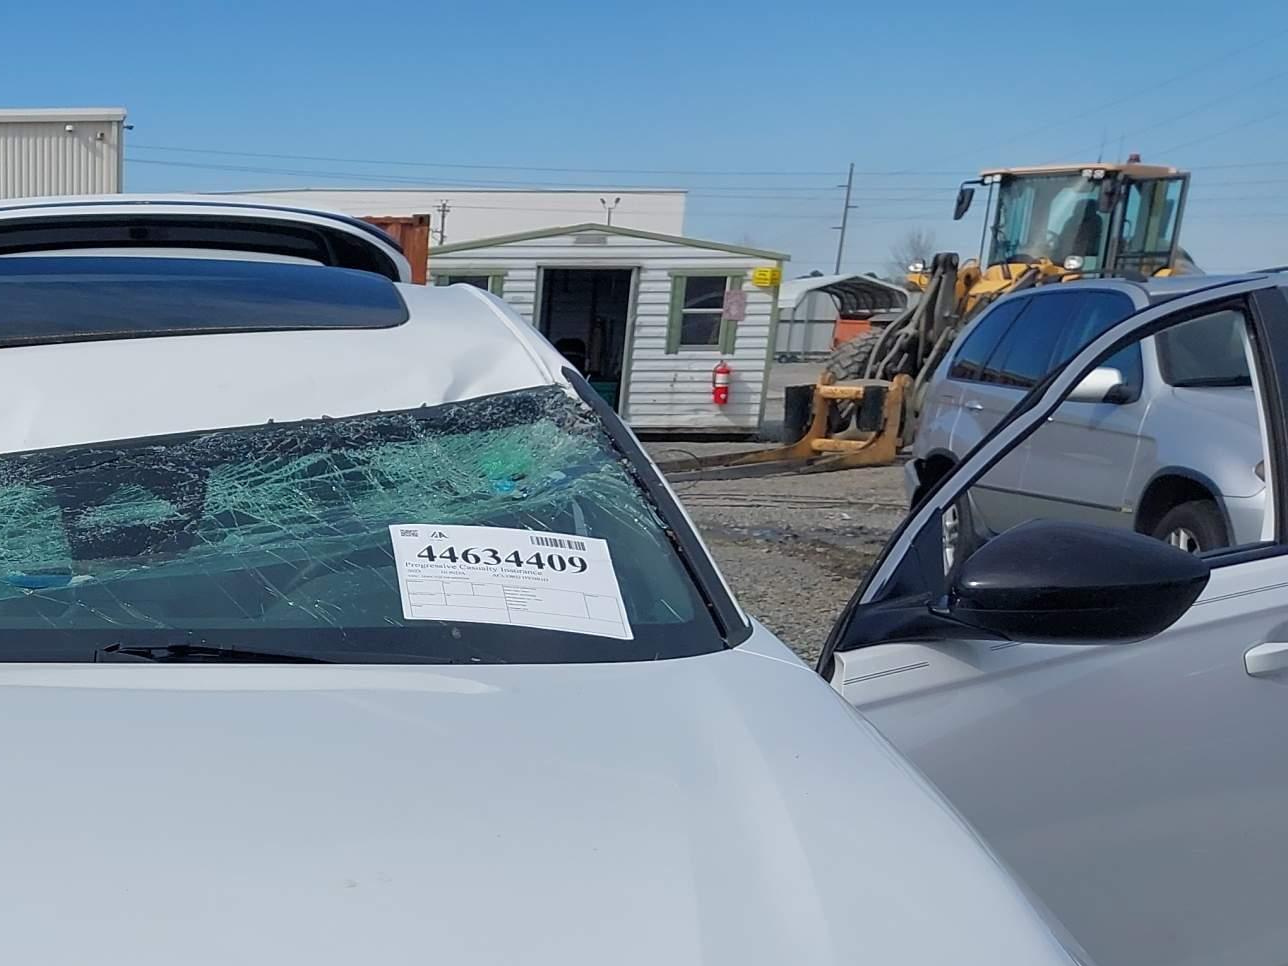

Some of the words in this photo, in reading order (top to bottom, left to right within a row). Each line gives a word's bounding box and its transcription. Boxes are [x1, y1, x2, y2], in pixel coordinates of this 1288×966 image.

[405, 561, 458, 570] Progressive
[459, 564, 498, 573] Casualty
[500, 567, 543, 576] Insurance
[417, 544, 588, 574] 44634409
